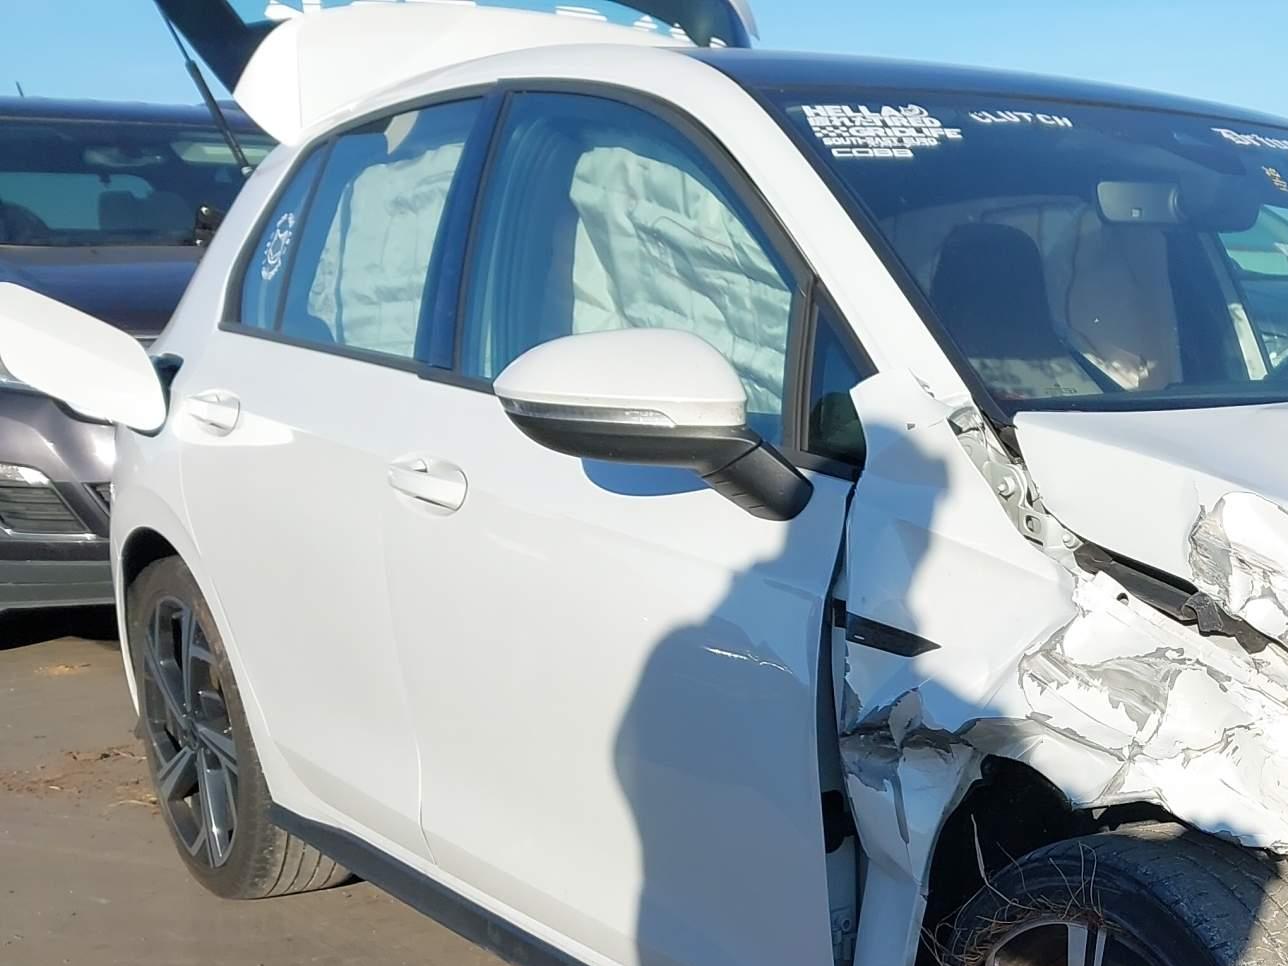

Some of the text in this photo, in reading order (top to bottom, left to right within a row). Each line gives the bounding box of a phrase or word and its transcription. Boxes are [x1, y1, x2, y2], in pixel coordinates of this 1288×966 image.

[801, 105, 905, 117] HELLA
[968, 111, 1073, 127] CLUTCH
[848, 127, 963, 139] GRIDLIFE
[831, 148, 914, 157] COBB
